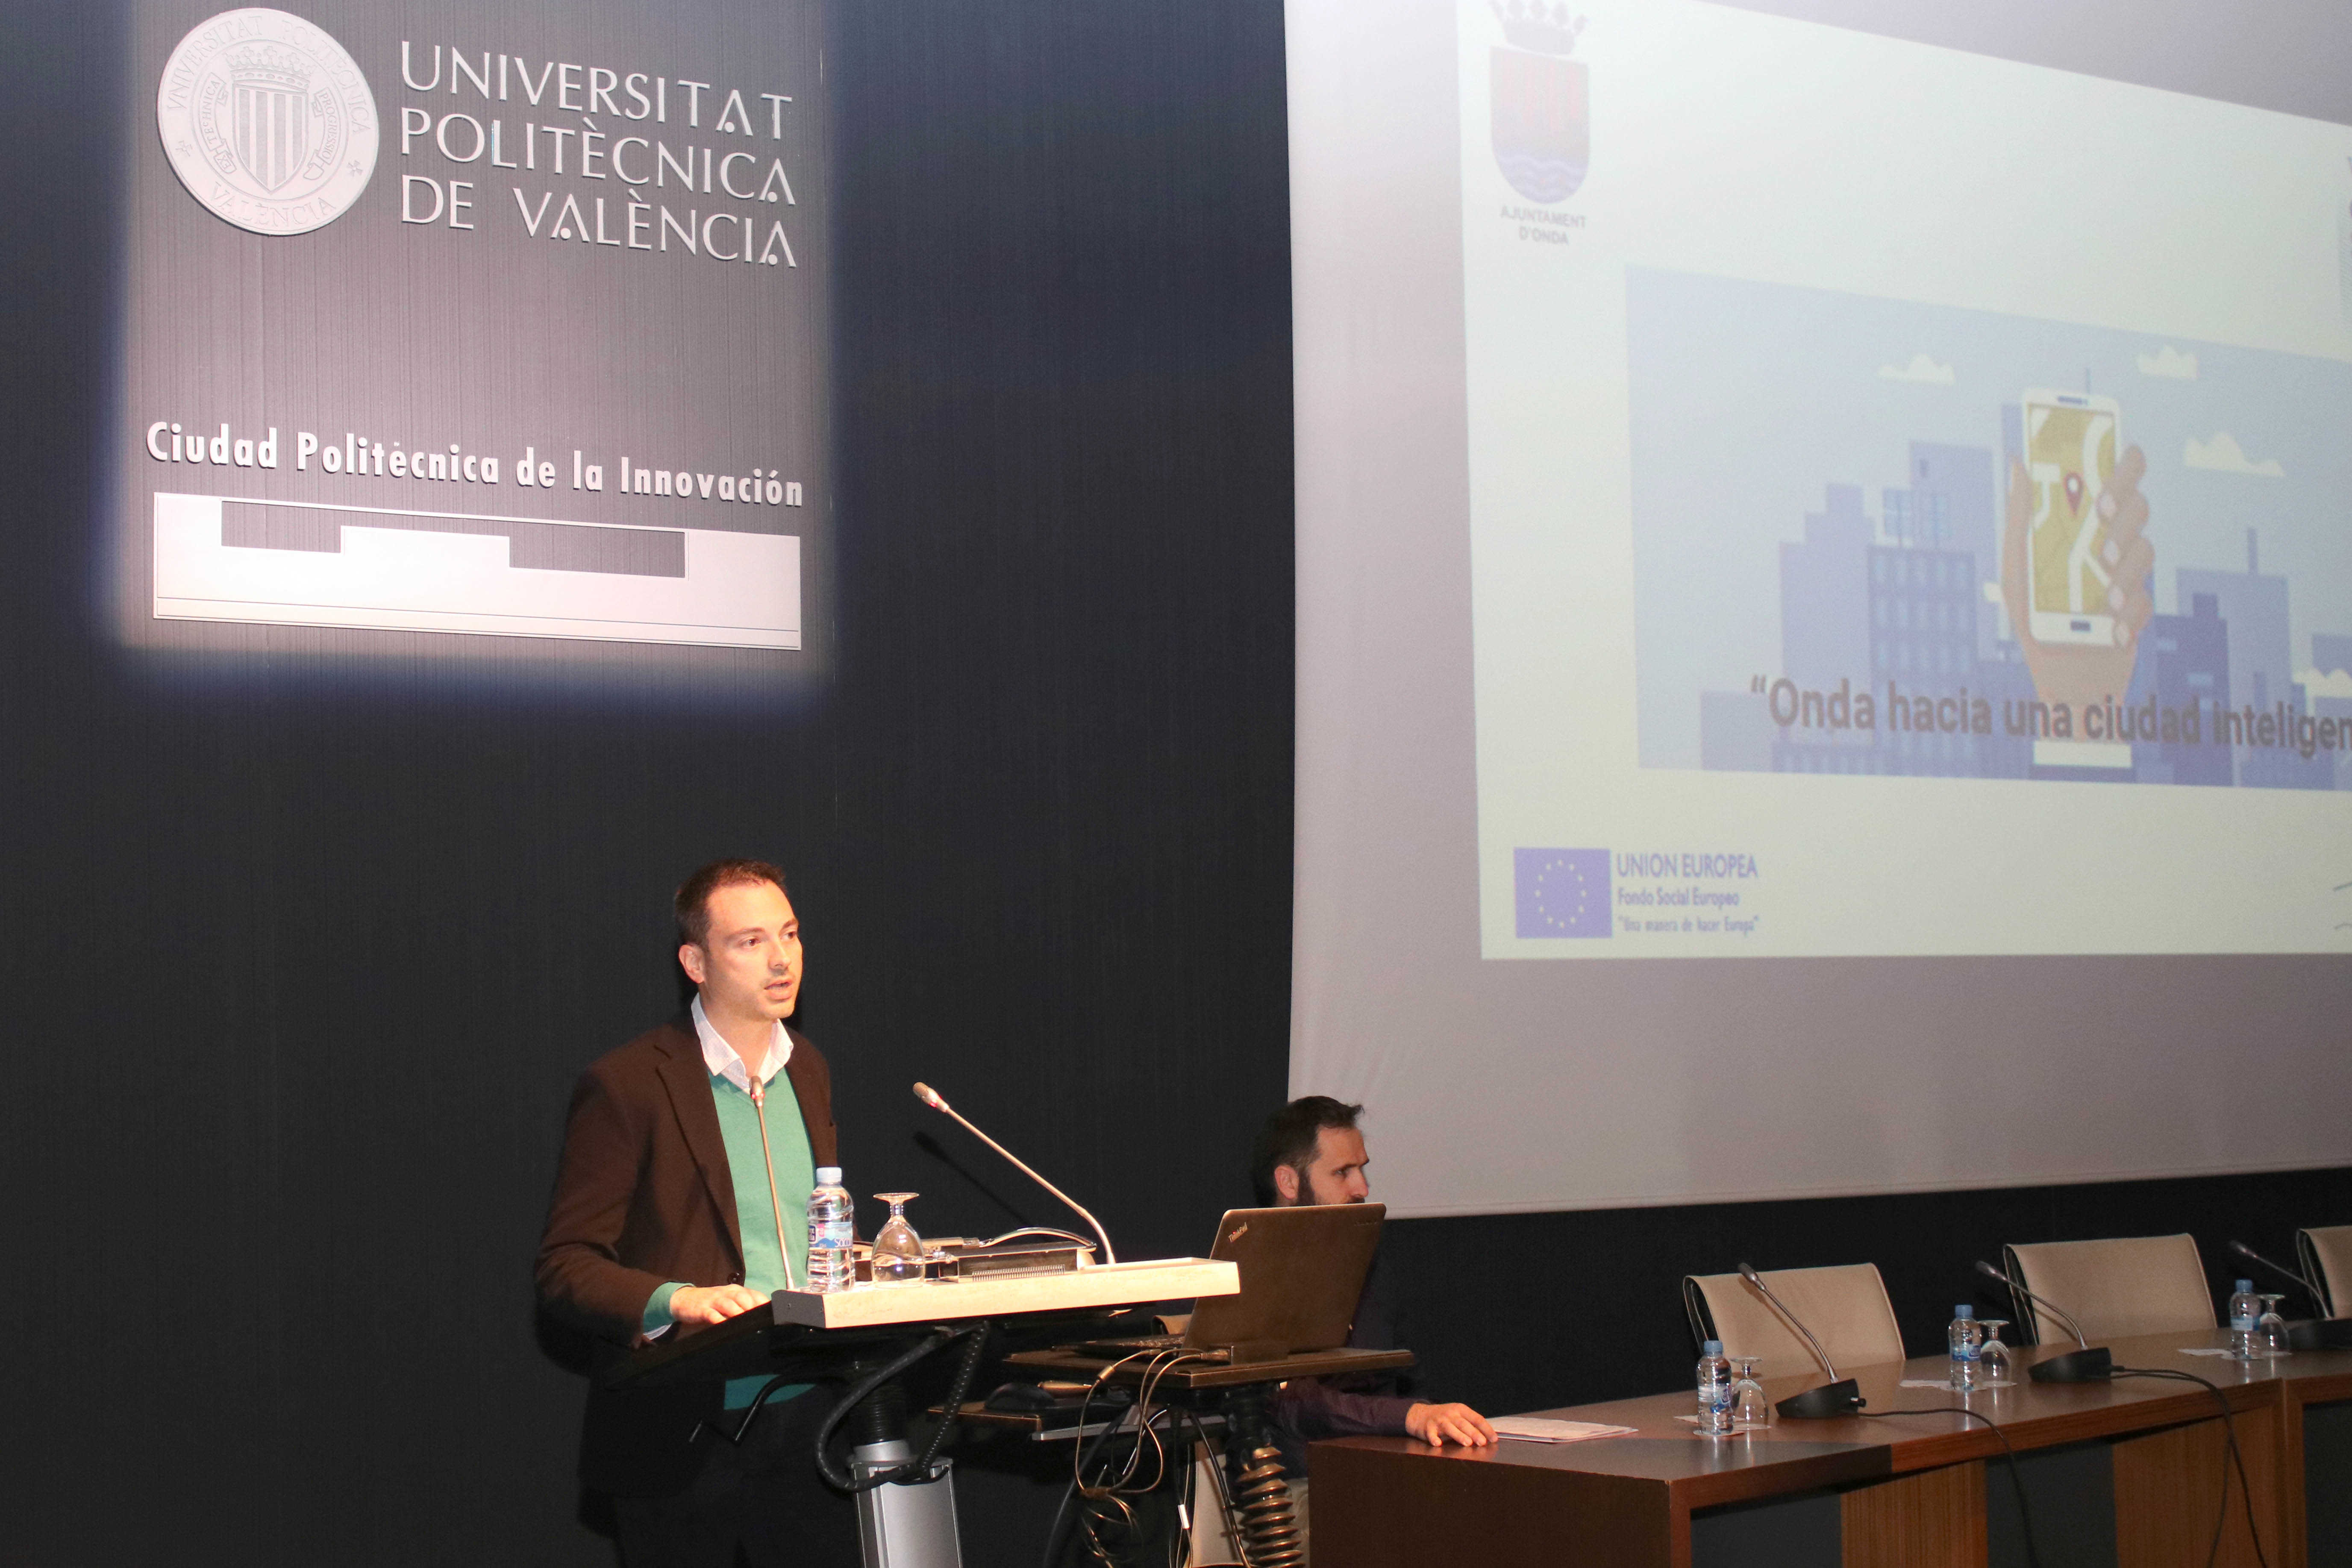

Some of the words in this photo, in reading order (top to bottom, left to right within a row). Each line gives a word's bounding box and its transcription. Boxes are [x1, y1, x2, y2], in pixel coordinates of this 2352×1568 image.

[402, 40, 793, 140] UNIVERSITAT
[401, 107, 796, 206] POLITÈCNICA
[401, 174, 474, 230] DE
[513, 188, 797, 267] VALÈNCIA
[1500, 204, 1586, 228] AJUNTAMENT
[146, 421, 278, 469] Ciudad
[516, 446, 556, 487] de
[573, 450, 603, 491] la
[620, 456, 803, 507] Innovación
[1887, 680, 1992, 735] hacia
[2005, 699, 2074, 739] una
[2083, 693, 2201, 745] ciudad
[1617, 853, 1678, 878] UNION
[1682, 853, 1759, 878] EUROPEA
[1618, 886, 1654, 906] Fondo
[1656, 886, 1689, 906] Social
[1692, 886, 1740, 910] Europeo
